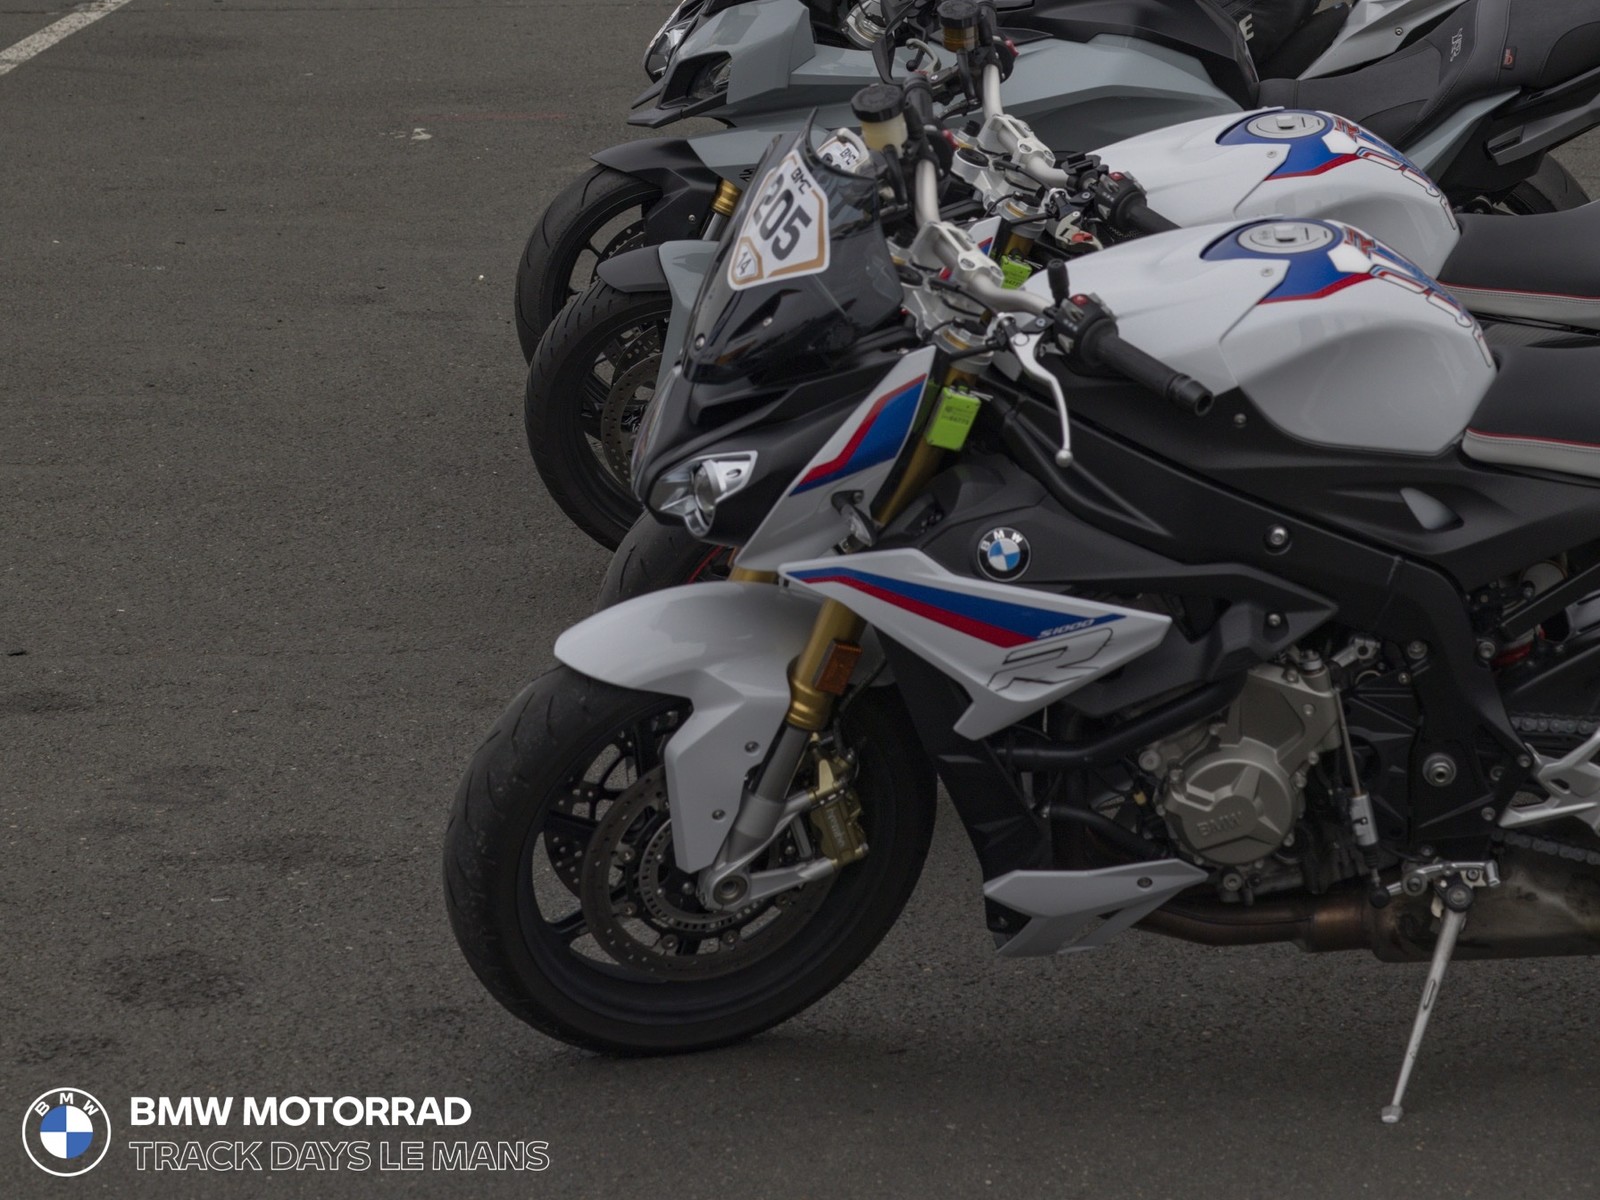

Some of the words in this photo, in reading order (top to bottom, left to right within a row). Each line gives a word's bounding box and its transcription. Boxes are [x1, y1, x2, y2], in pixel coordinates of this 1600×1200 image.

[791, 167, 812, 195] BMC
[753, 173, 812, 261] 205
[979, 528, 1023, 552] BMW
[1038, 618, 1095, 639] S1000
